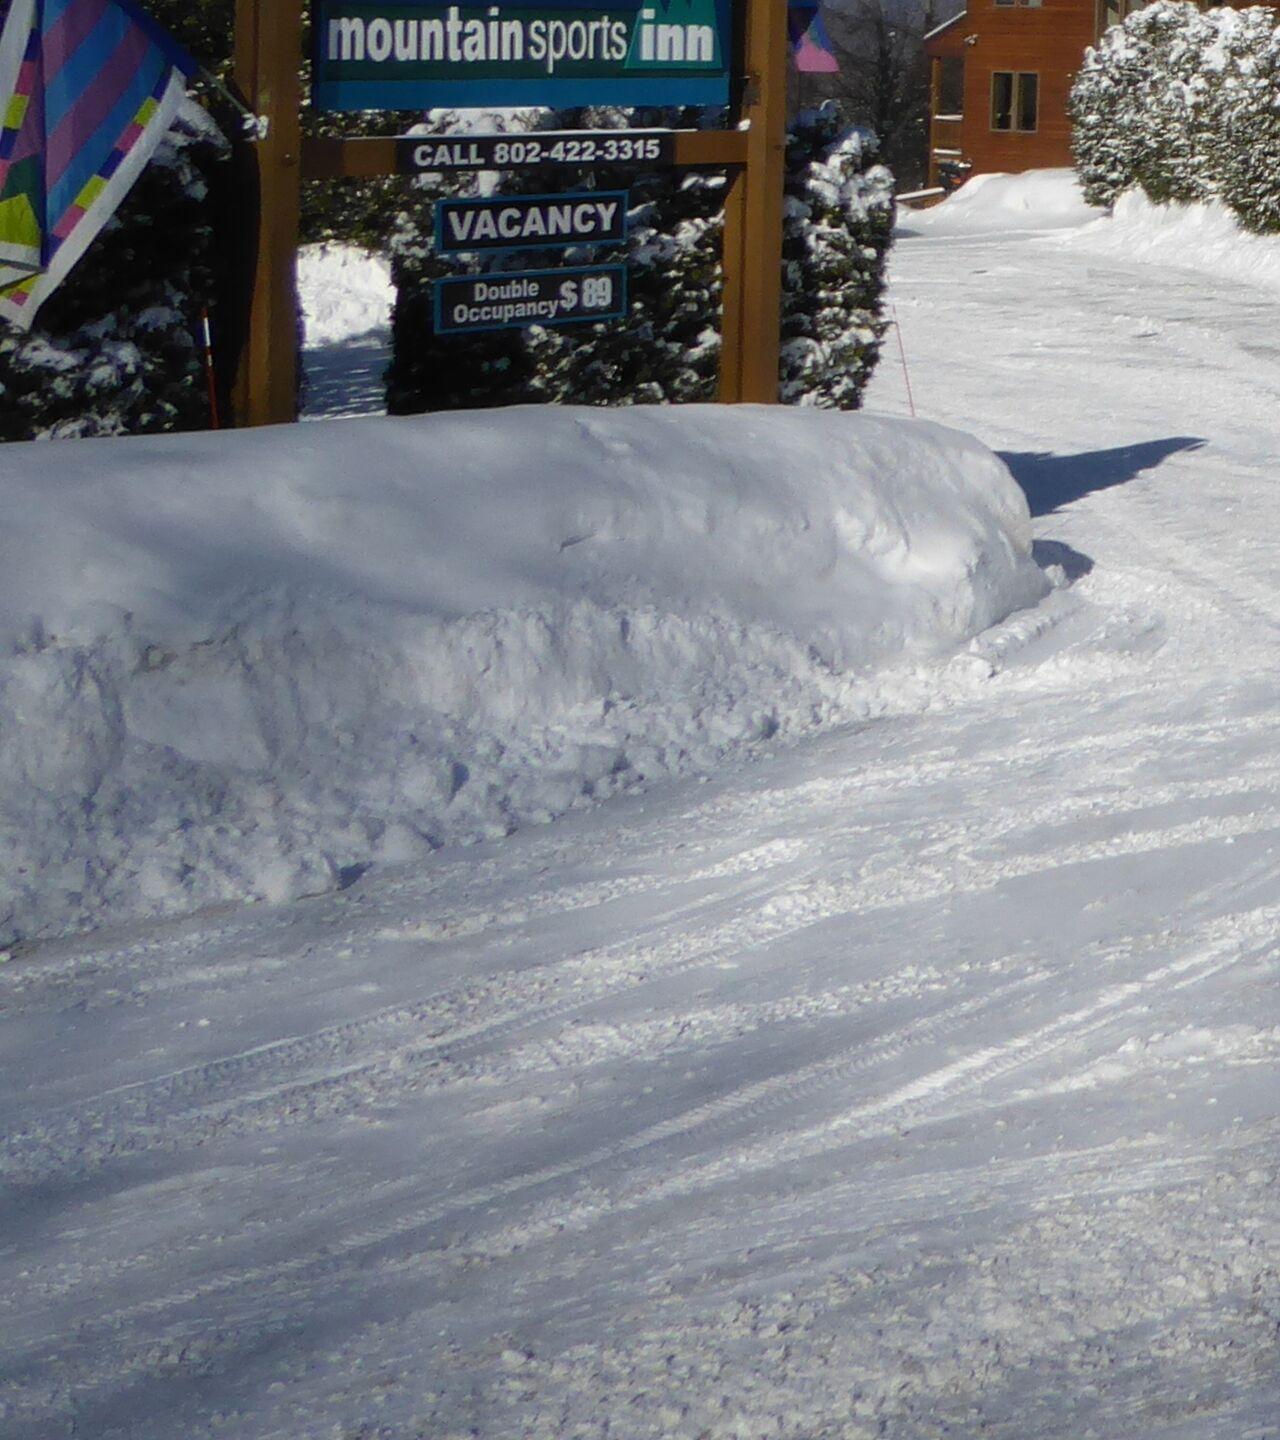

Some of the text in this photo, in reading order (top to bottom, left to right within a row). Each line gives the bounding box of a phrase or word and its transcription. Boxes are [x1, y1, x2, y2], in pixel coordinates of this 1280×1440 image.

[328, 6, 714, 74] mountain sports inn
[414, 139, 660, 166] CALL 802-422-3315
[448, 202, 618, 242] VACANCY
[473, 278, 540, 302] Double
[453, 299, 559, 324] Occupancy
